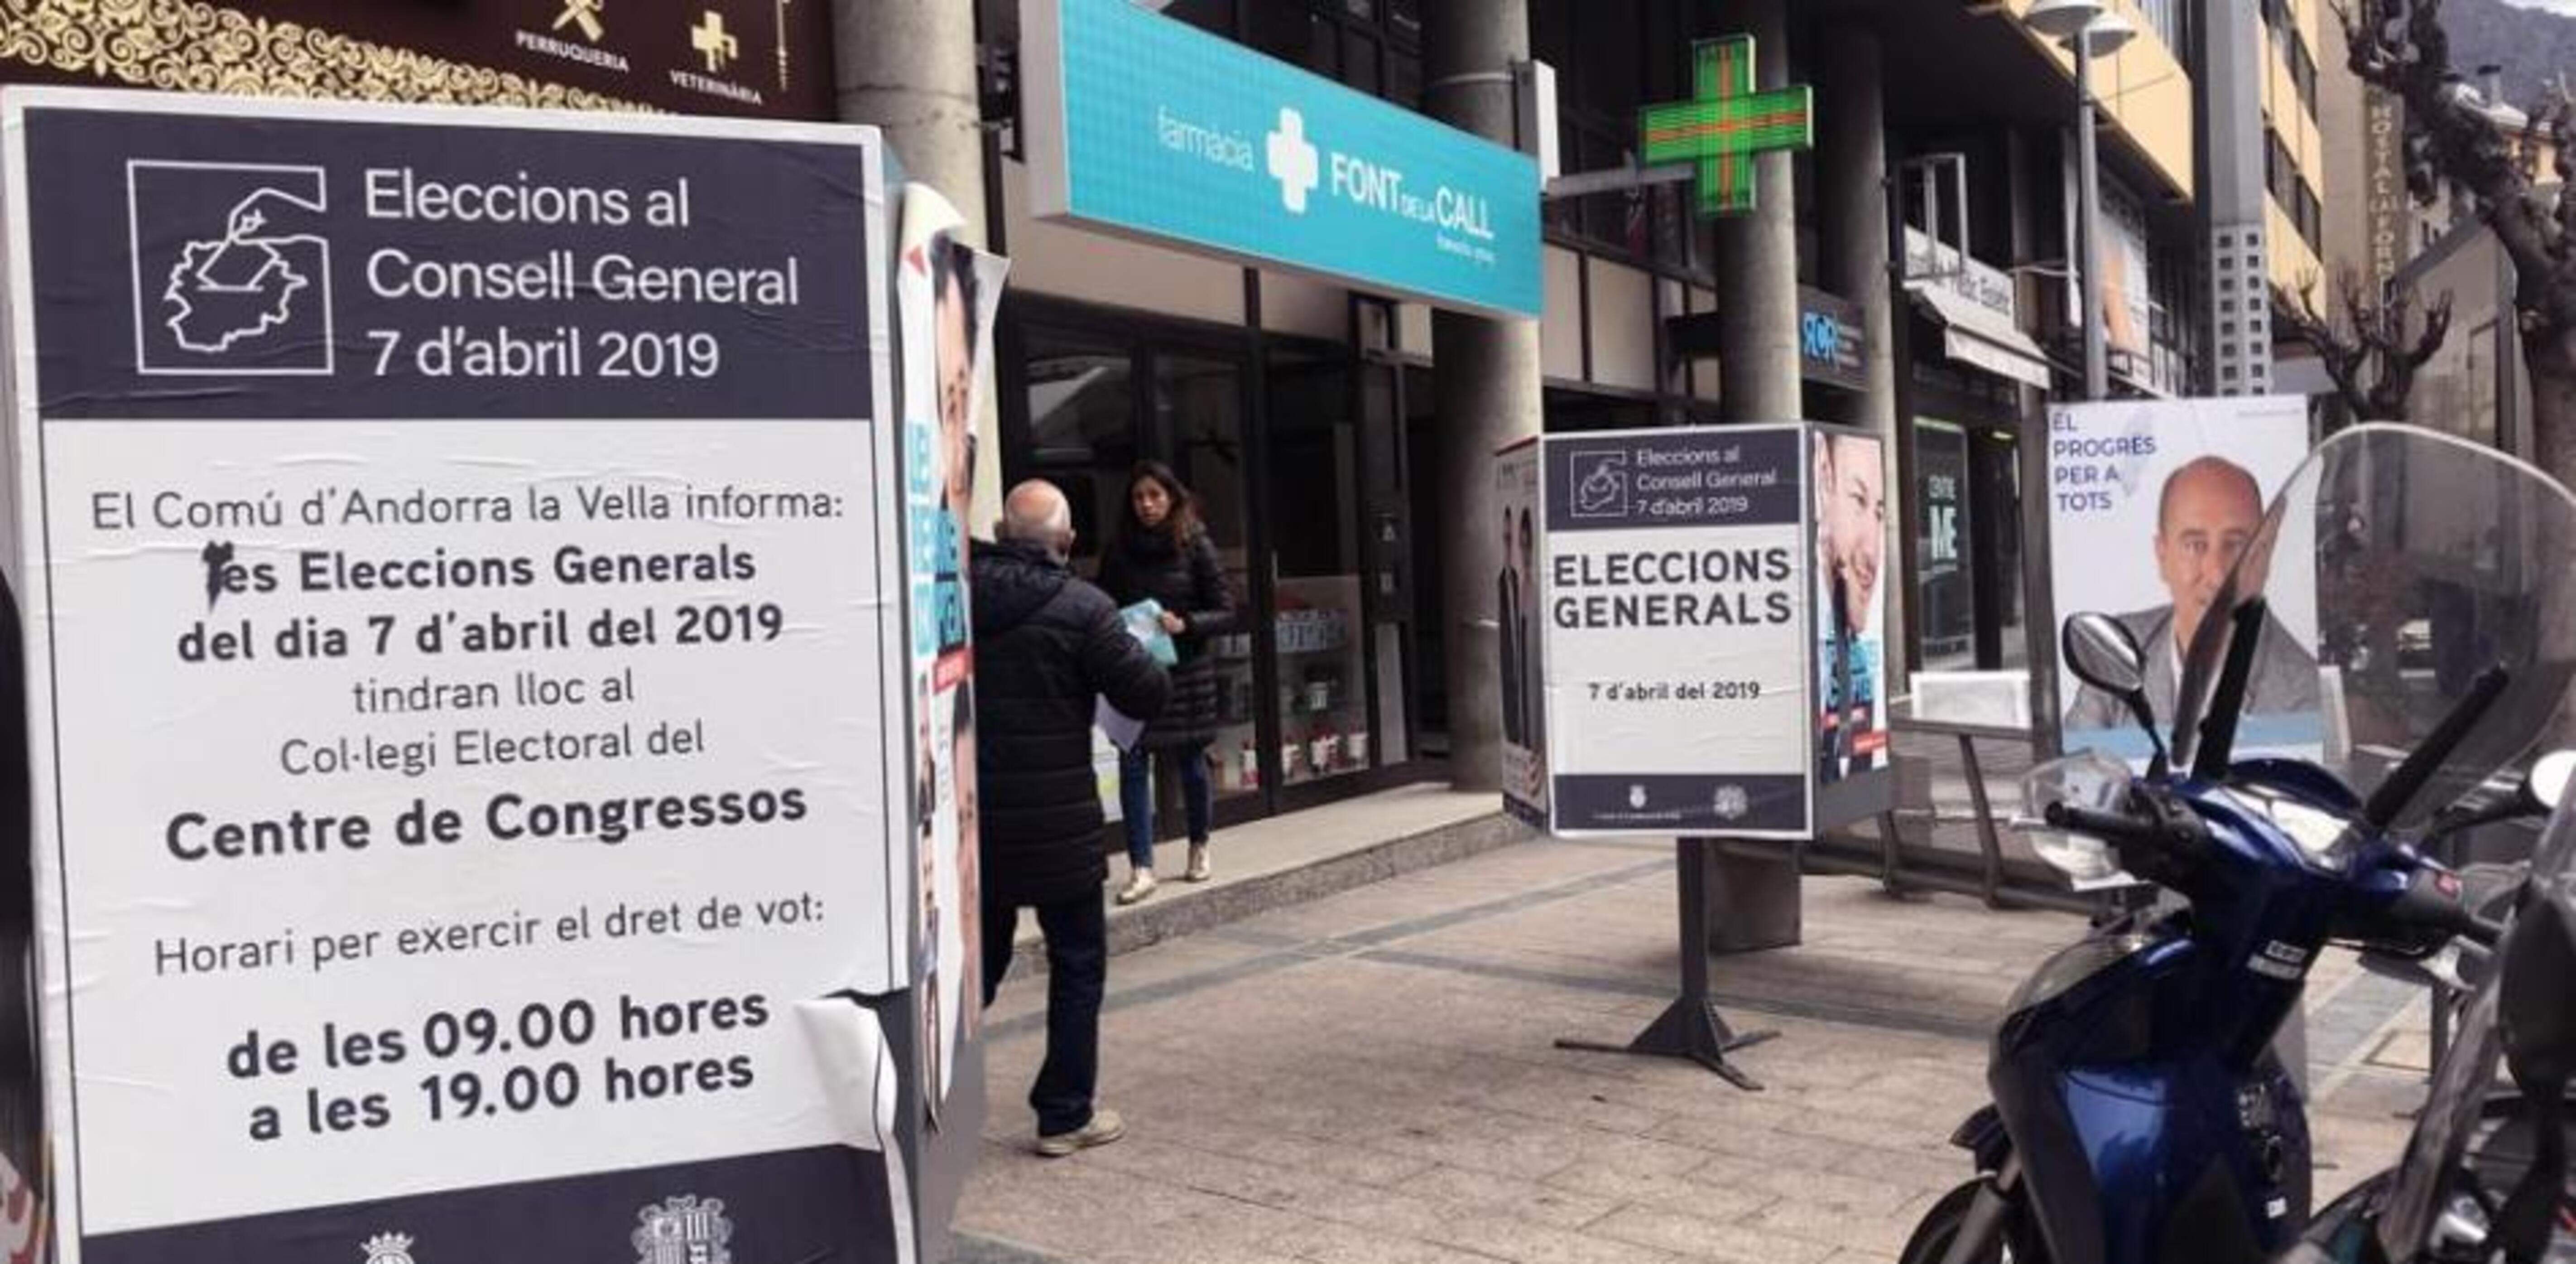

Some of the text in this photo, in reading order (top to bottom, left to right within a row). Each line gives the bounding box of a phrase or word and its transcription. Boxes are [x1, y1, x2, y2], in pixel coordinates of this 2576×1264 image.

[515, 30, 630, 72] PERRUQUERIA
[365, 168, 689, 227] Eleccions al
[1331, 152, 1402, 212] FONT
[1437, 186, 1494, 240] CALL
[367, 248, 798, 305] Consell General
[368, 330, 400, 376] 7
[598, 331, 719, 377] 2019
[2053, 413, 2078, 431] EL
[1637, 445, 1740, 465] Eleccions al
[2054, 465, 2121, 486] PER A
[1636, 469, 1777, 491] Consell General
[2057, 491, 2112, 511] TOTS
[92, 492, 135, 530] El
[153, 491, 282, 529] Comú
[529, 486, 561, 521] la
[577, 485, 670, 521] Vella
[687, 484, 842, 519] informa:
[1637, 499, 1647, 514] 7
[1707, 496, 1749, 514] 2019
[1929, 506, 1957, 559] ME
[300, 547, 534, 591] Eleccions
[554, 543, 756, 584] Generals
[1554, 548, 1791, 587] ELECCIONS
[178, 620, 254, 662] del
[275, 617, 347, 659] dia
[368, 615, 395, 655] 7
[588, 608, 656, 648] del
[676, 603, 782, 644] 2019
[1554, 591, 1791, 629] GENERALS
[353, 667, 634, 713] tindran lloc al
[1588, 682, 1601, 700] 7
[1675, 682, 1705, 700] del
[1712, 681, 1760, 699] 2019
[455, 722, 632, 766] Electoral
[647, 719, 704, 756] del
[166, 788, 807, 861] Centre de Congressos
[155, 892, 823, 976] Horari per exercir el dret de vot:
[228, 994, 769, 1079] de les 09.00 hores
[250, 1055, 754, 1141] a les 19.00 hores
